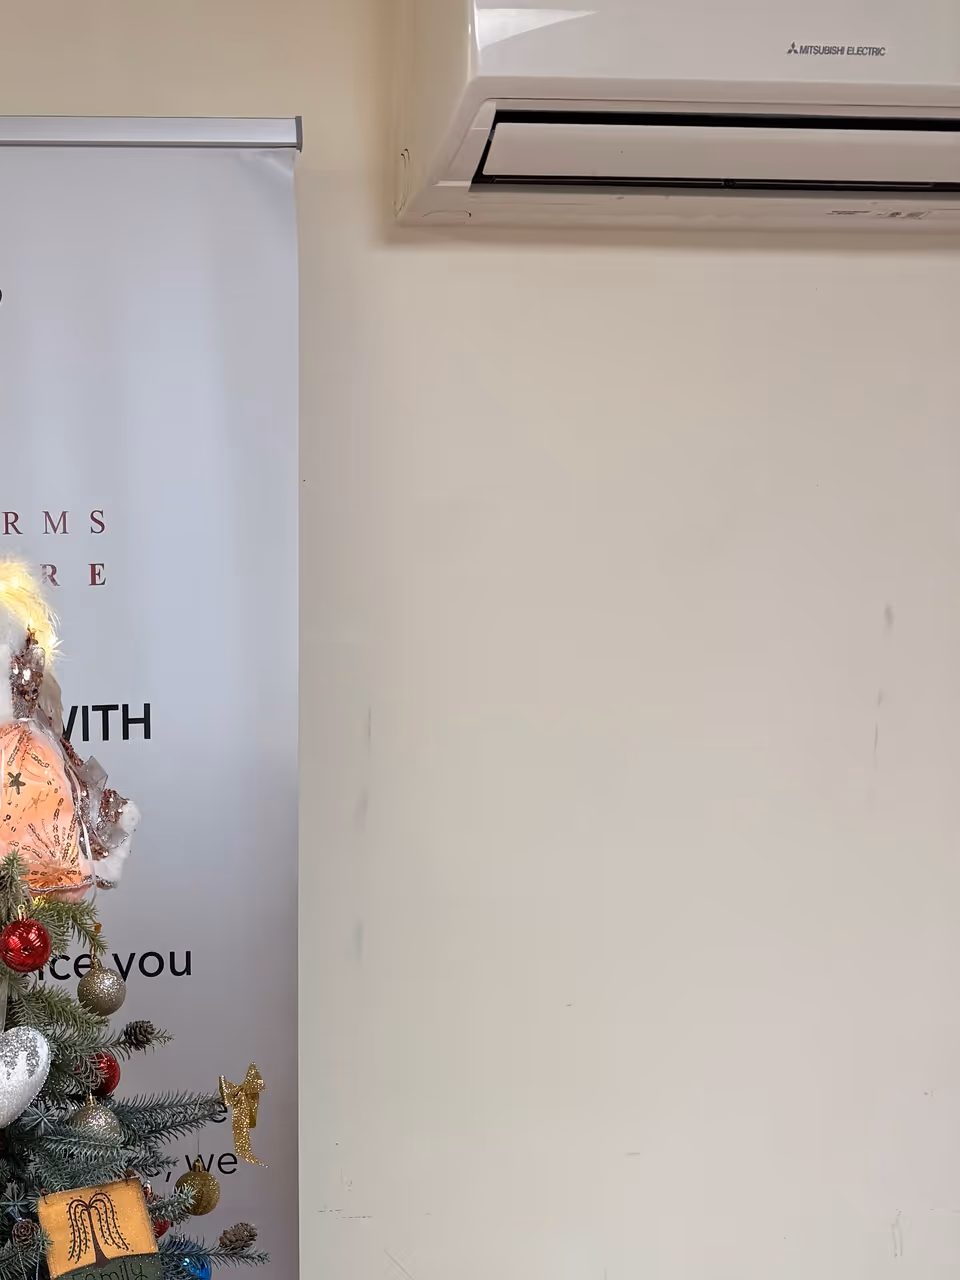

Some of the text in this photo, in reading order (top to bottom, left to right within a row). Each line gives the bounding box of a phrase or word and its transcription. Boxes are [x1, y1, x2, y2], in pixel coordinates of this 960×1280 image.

[799, 45, 886, 56] MITSUBISHI ELECTRIC
[40, 562, 107, 587] RE
[112, 950, 192, 982] you
[185, 1151, 238, 1175] we
